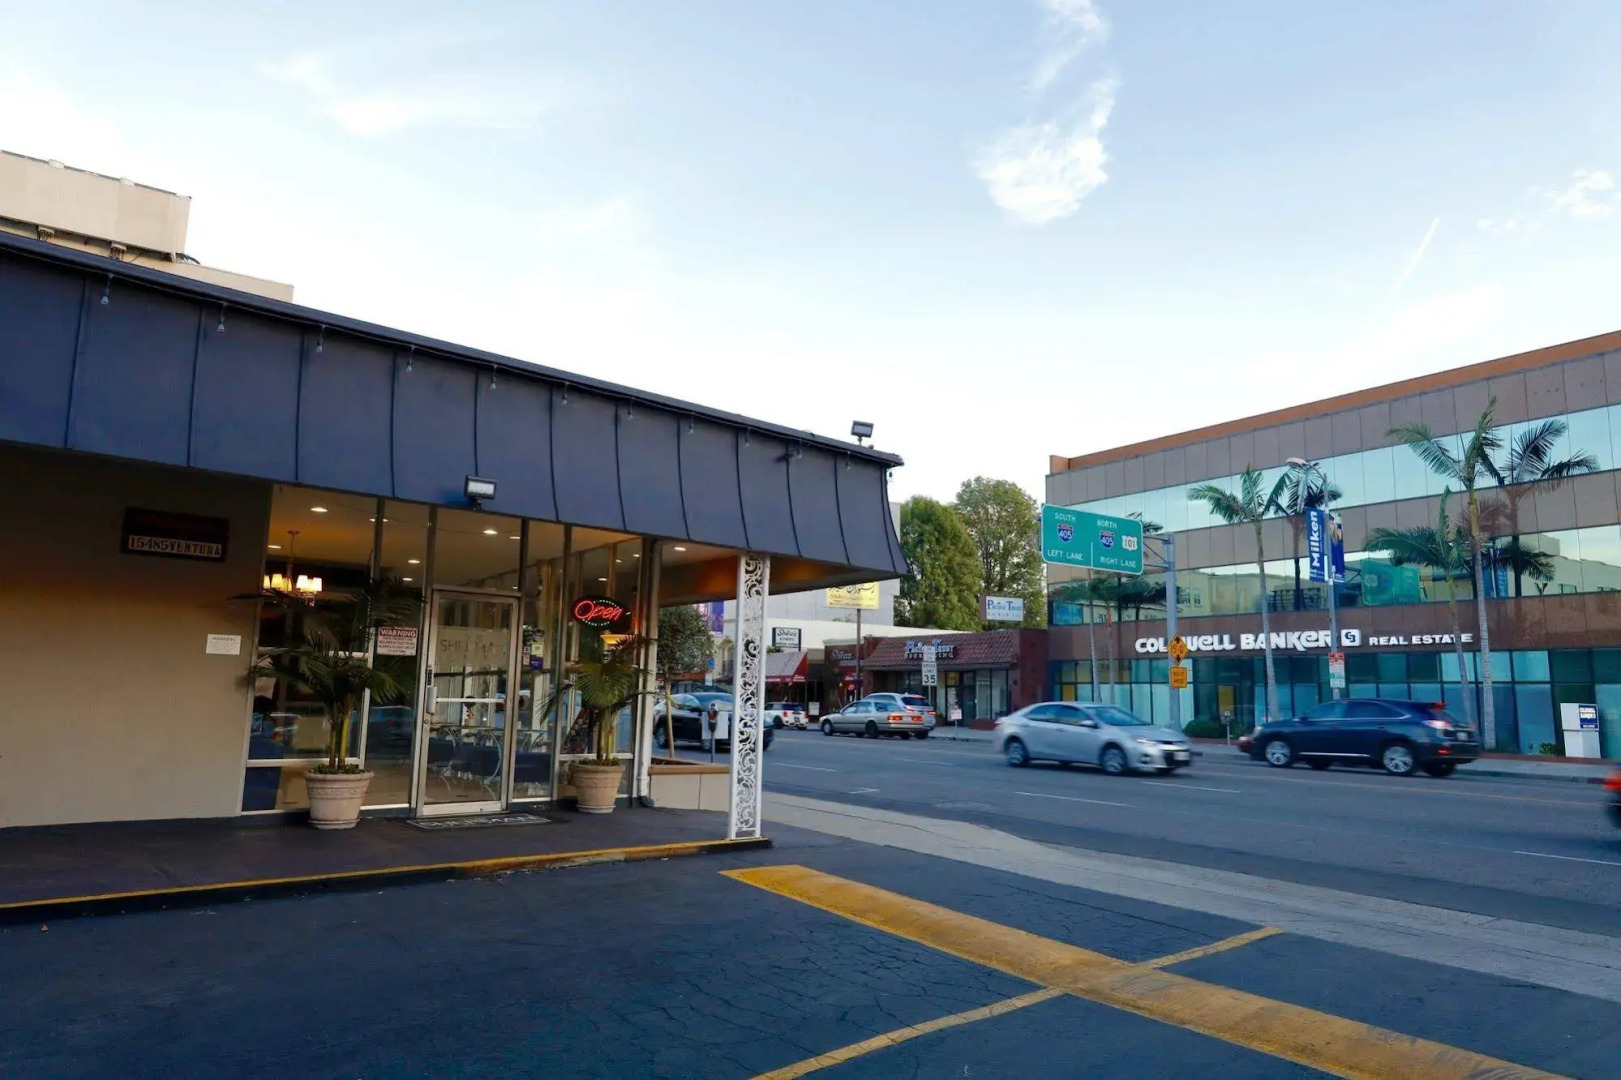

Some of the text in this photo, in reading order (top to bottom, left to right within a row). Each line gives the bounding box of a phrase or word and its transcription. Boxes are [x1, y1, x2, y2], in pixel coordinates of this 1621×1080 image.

[1054, 512, 1077, 523] SOUTH
[1096, 519, 1118, 530] NORTH
[1058, 530, 1073, 541] 405
[1310, 511, 1321, 567] Milken
[1101, 536, 1115, 547] 405
[1124, 538, 1137, 548] 101
[1047, 548, 1084, 561] LEFT LANE
[1099, 556, 1137, 568] RIGHT LANE
[575, 600, 623, 621] Open
[380, 629, 416, 637] WARNING
[1368, 636, 1409, 646] REAL
[923, 674, 936, 684] 35
